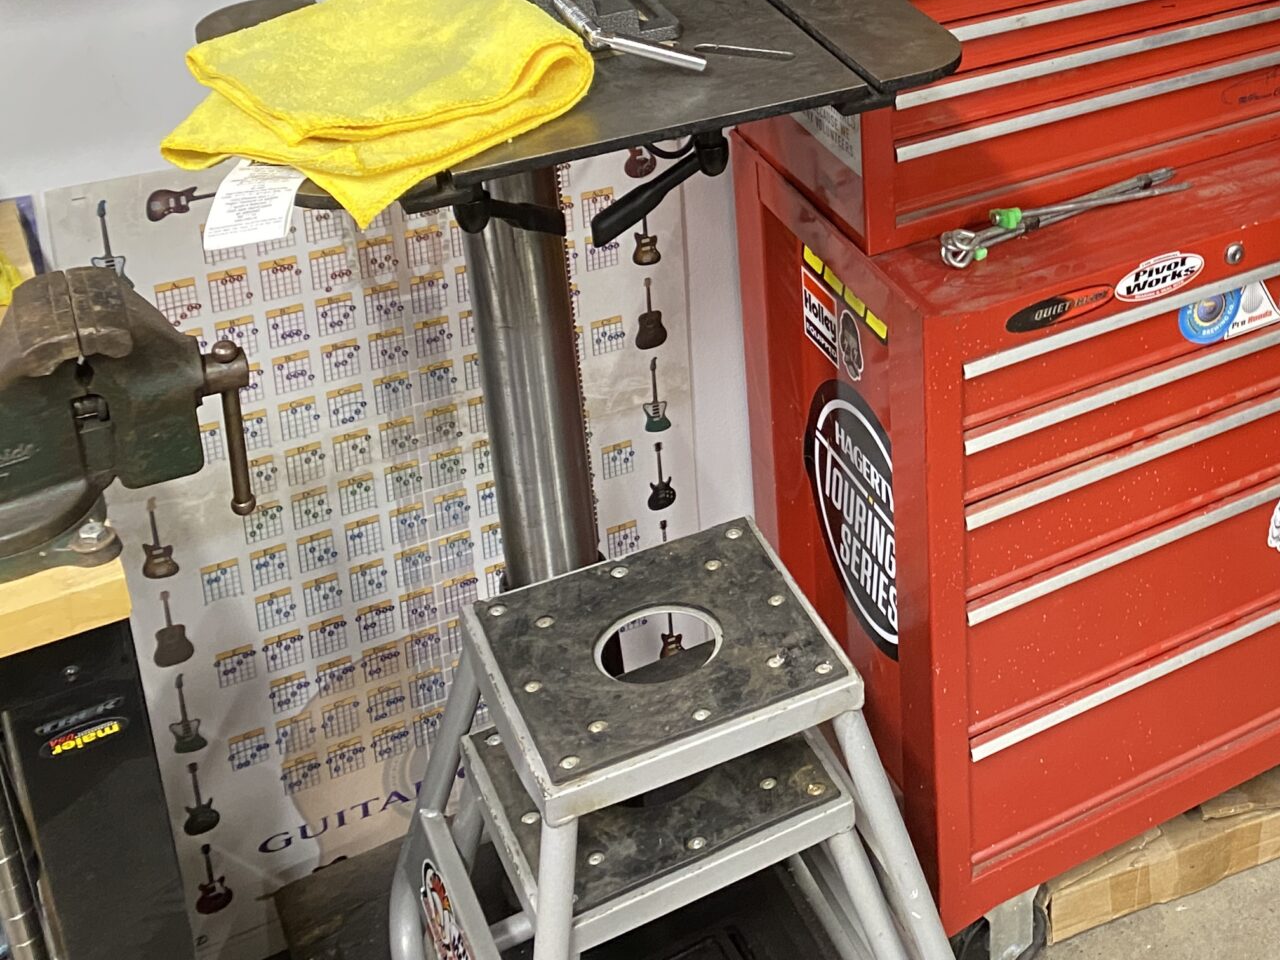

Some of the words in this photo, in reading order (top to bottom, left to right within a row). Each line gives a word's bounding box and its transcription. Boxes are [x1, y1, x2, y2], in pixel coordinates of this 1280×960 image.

[804, 289, 837, 344] Holley
[1034, 300, 1072, 321] QUIET
[1231, 319, 1246, 330] Pro
[1247, 310, 1273, 324] Honda
[835, 420, 895, 513] HAGERTY
[824, 446, 897, 580] TOURING
[839, 523, 898, 633] SERIES
